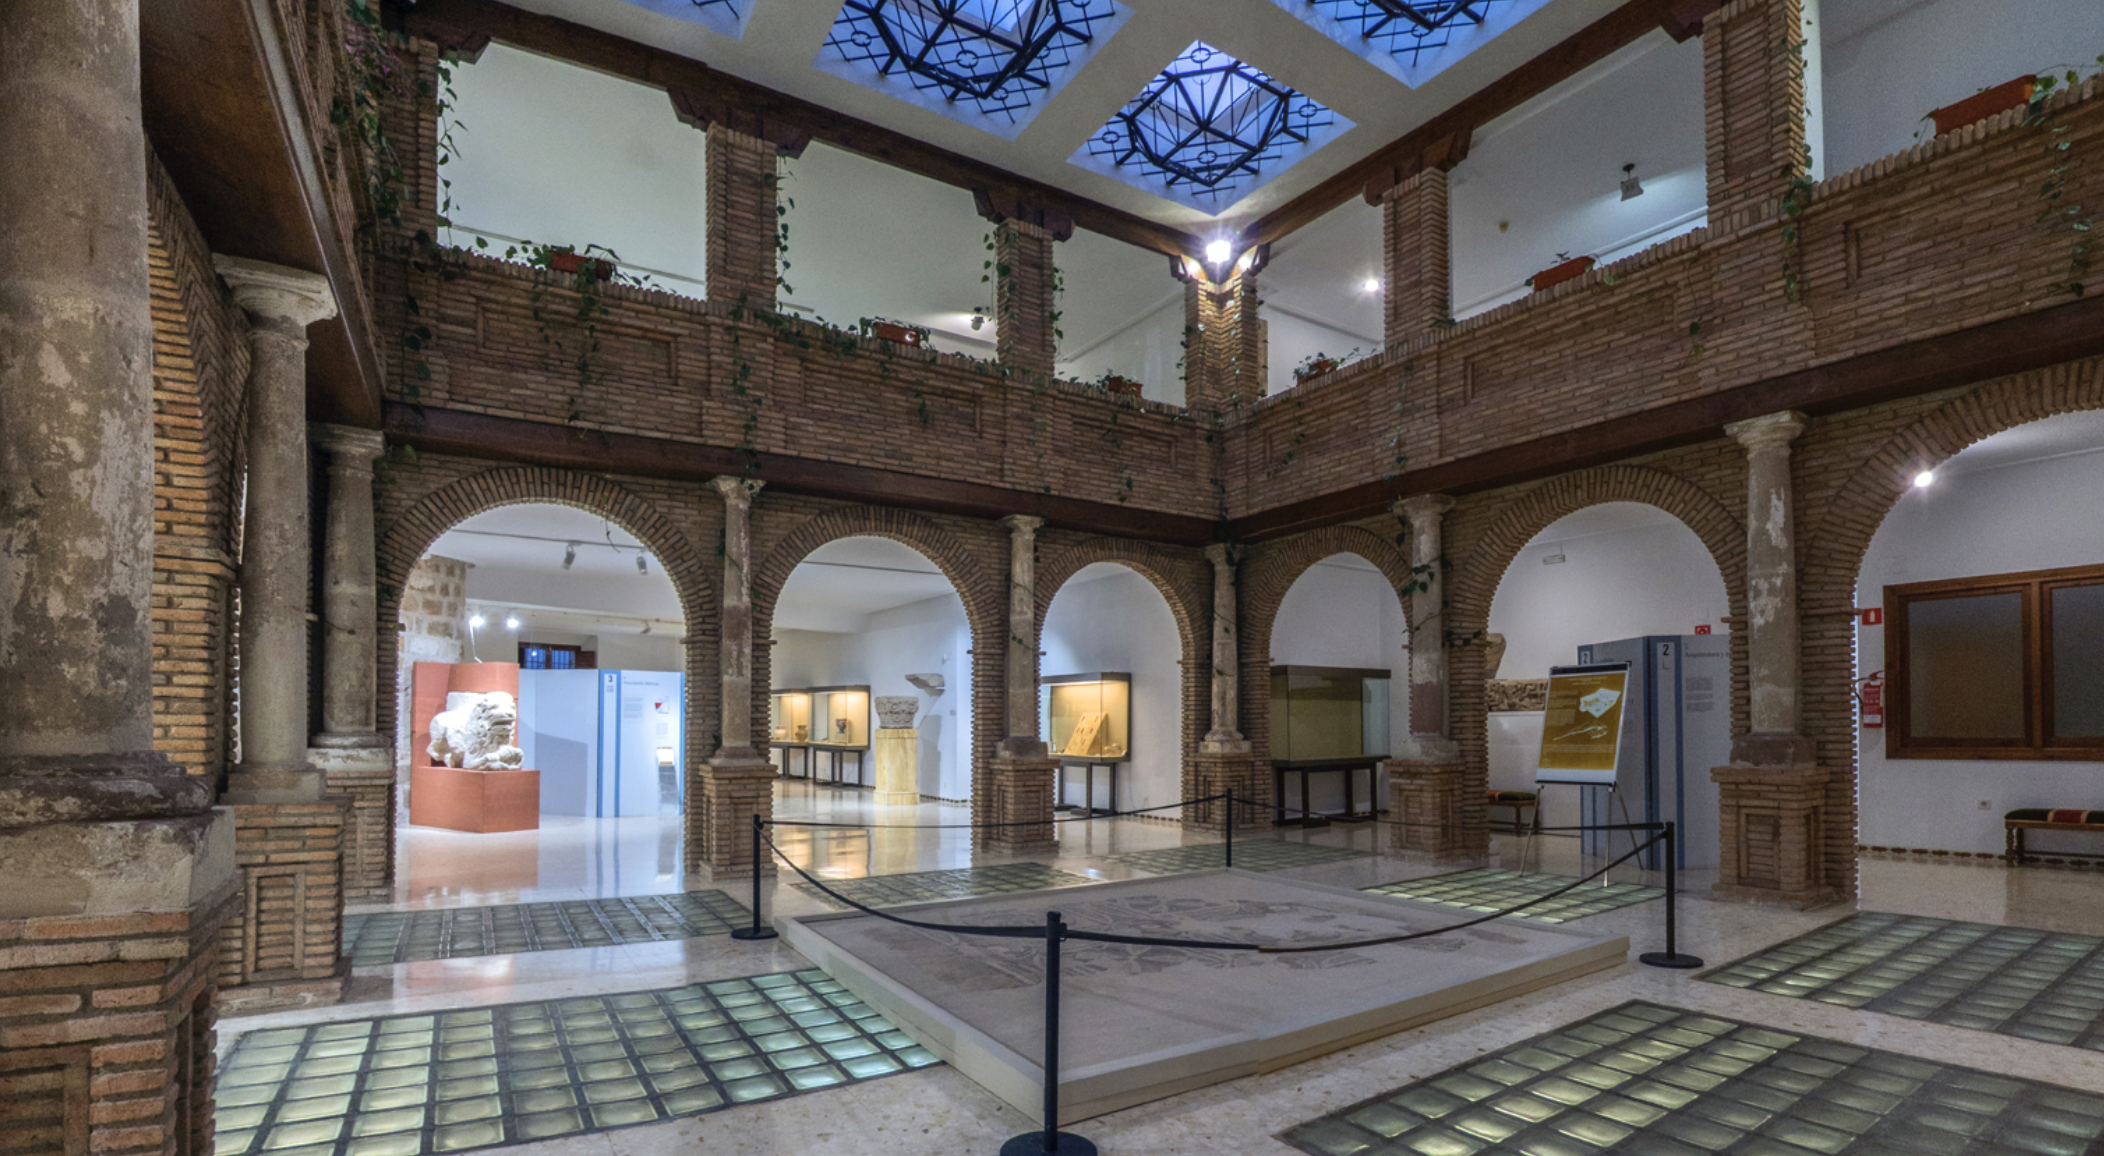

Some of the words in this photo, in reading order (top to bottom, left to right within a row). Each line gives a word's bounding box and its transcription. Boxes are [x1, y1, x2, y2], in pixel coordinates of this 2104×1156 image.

[1663, 644, 1669, 656] 2
[1583, 653, 1588, 664] 2
[607, 674, 613, 682] 3
